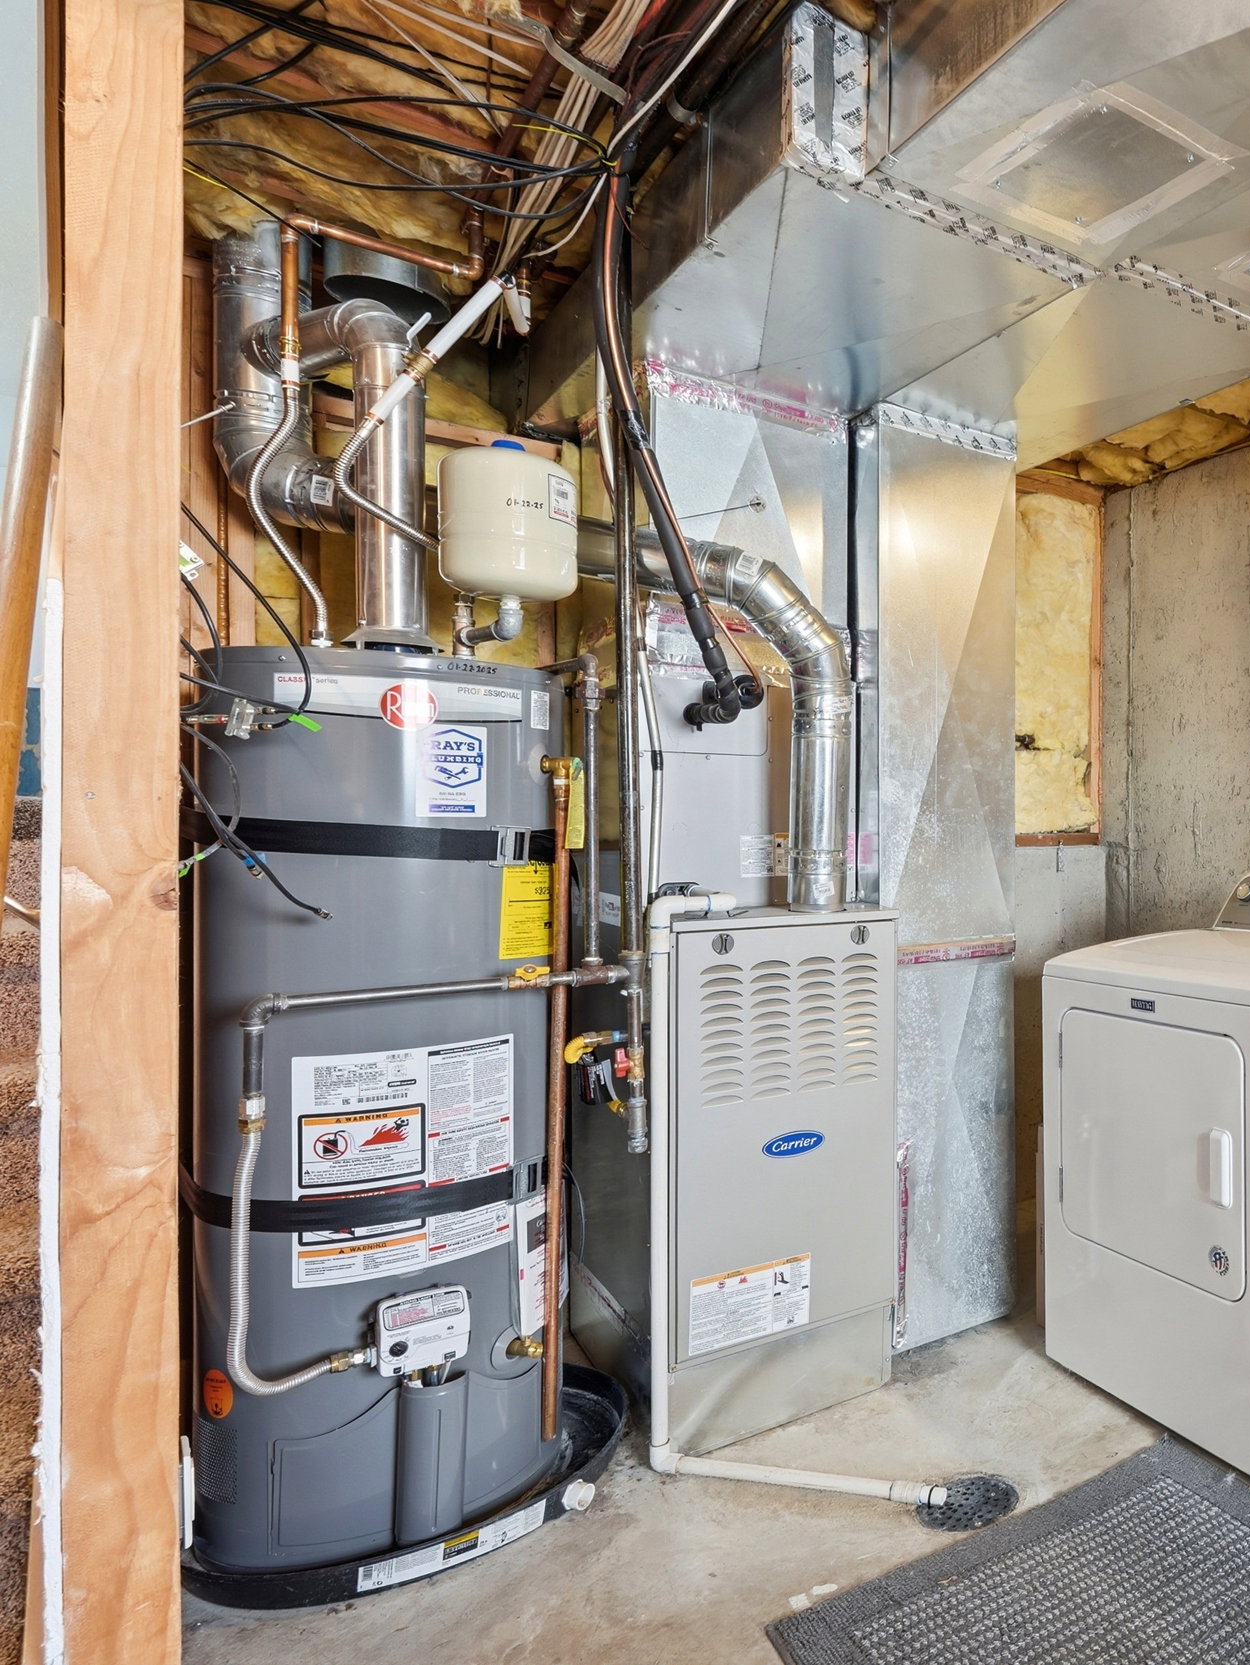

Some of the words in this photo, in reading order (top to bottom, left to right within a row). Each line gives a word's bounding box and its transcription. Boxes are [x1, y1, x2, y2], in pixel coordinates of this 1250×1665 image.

[431, 740, 475, 752] RAY'S
[345, 1113, 388, 1122] WARNING
[772, 1137, 817, 1152] Carrier
[349, 1242, 387, 1253] WARNING
